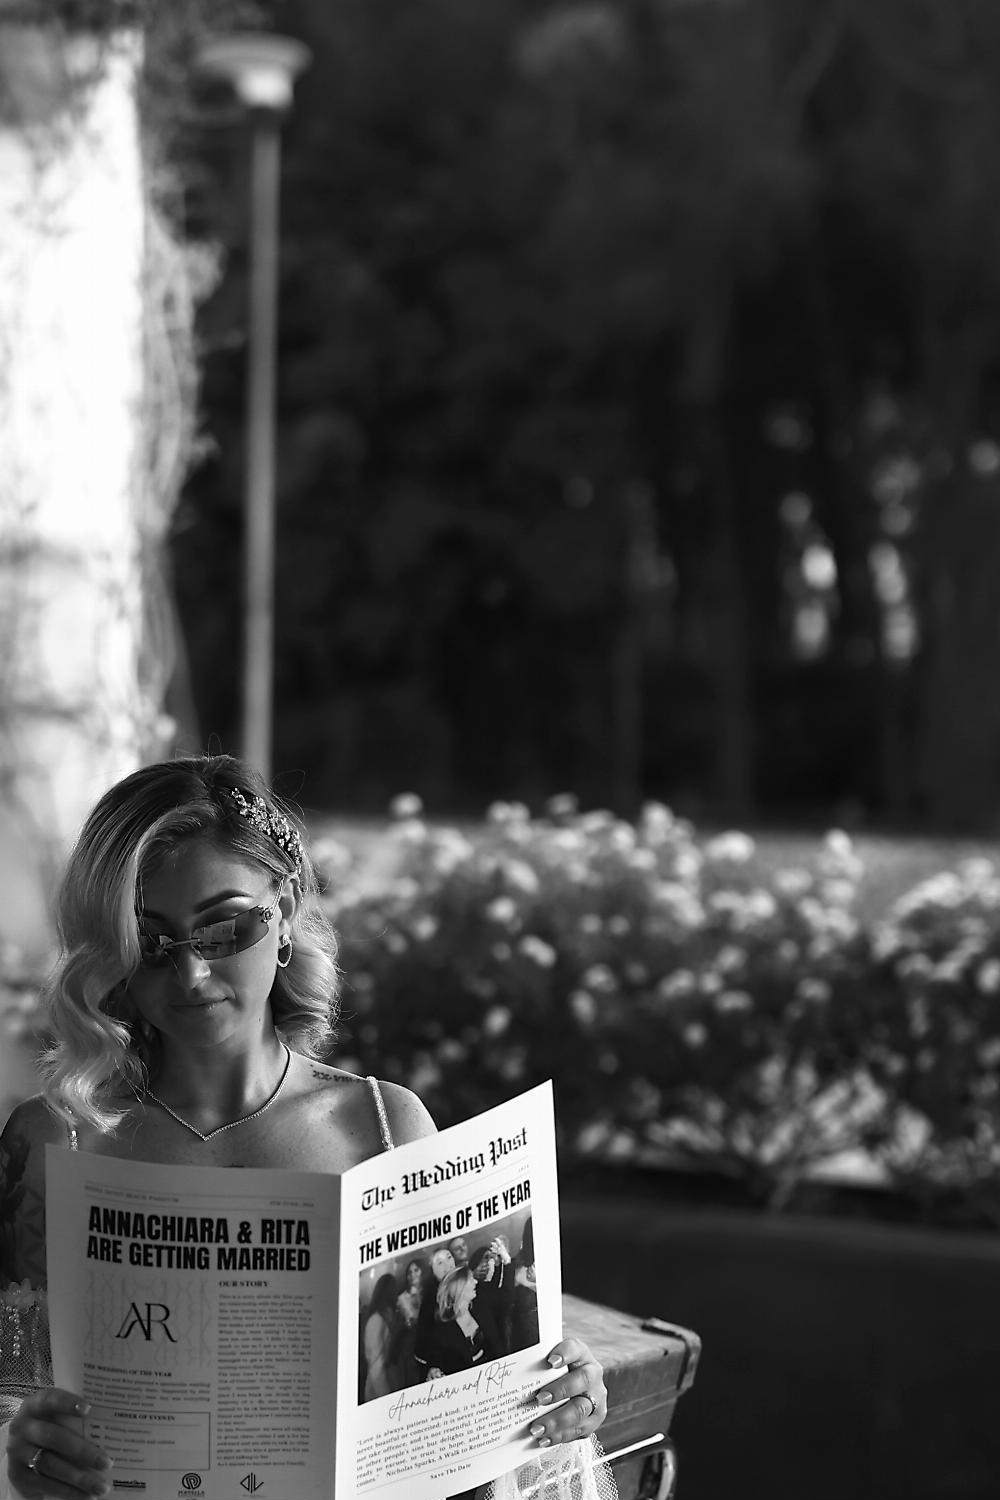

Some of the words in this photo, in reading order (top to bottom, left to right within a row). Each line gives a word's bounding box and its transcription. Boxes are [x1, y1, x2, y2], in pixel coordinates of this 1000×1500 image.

[362, 1186, 396, 1211] The
[401, 1153, 485, 1194] Wedding
[488, 1127, 528, 1166] Post
[88, 1206, 229, 1244] ANNACHIARA
[237, 1220, 252, 1244] &
[261, 1218, 310, 1246] RITA
[360, 1237, 382, 1264] THE
[386, 1214, 452, 1252] WEDDING
[456, 1206, 472, 1230] OF
[476, 1195, 499, 1222] THE
[502, 1180, 531, 1210] YEAR
[86, 1235, 122, 1264] ARE
[129, 1242, 210, 1270] GETTING
[217, 1248, 310, 1272] MARRIED
[388, 1383, 460, 1421] Annachiara
[462, 1370, 482, 1394] and
[485, 1362, 516, 1392] Rita
